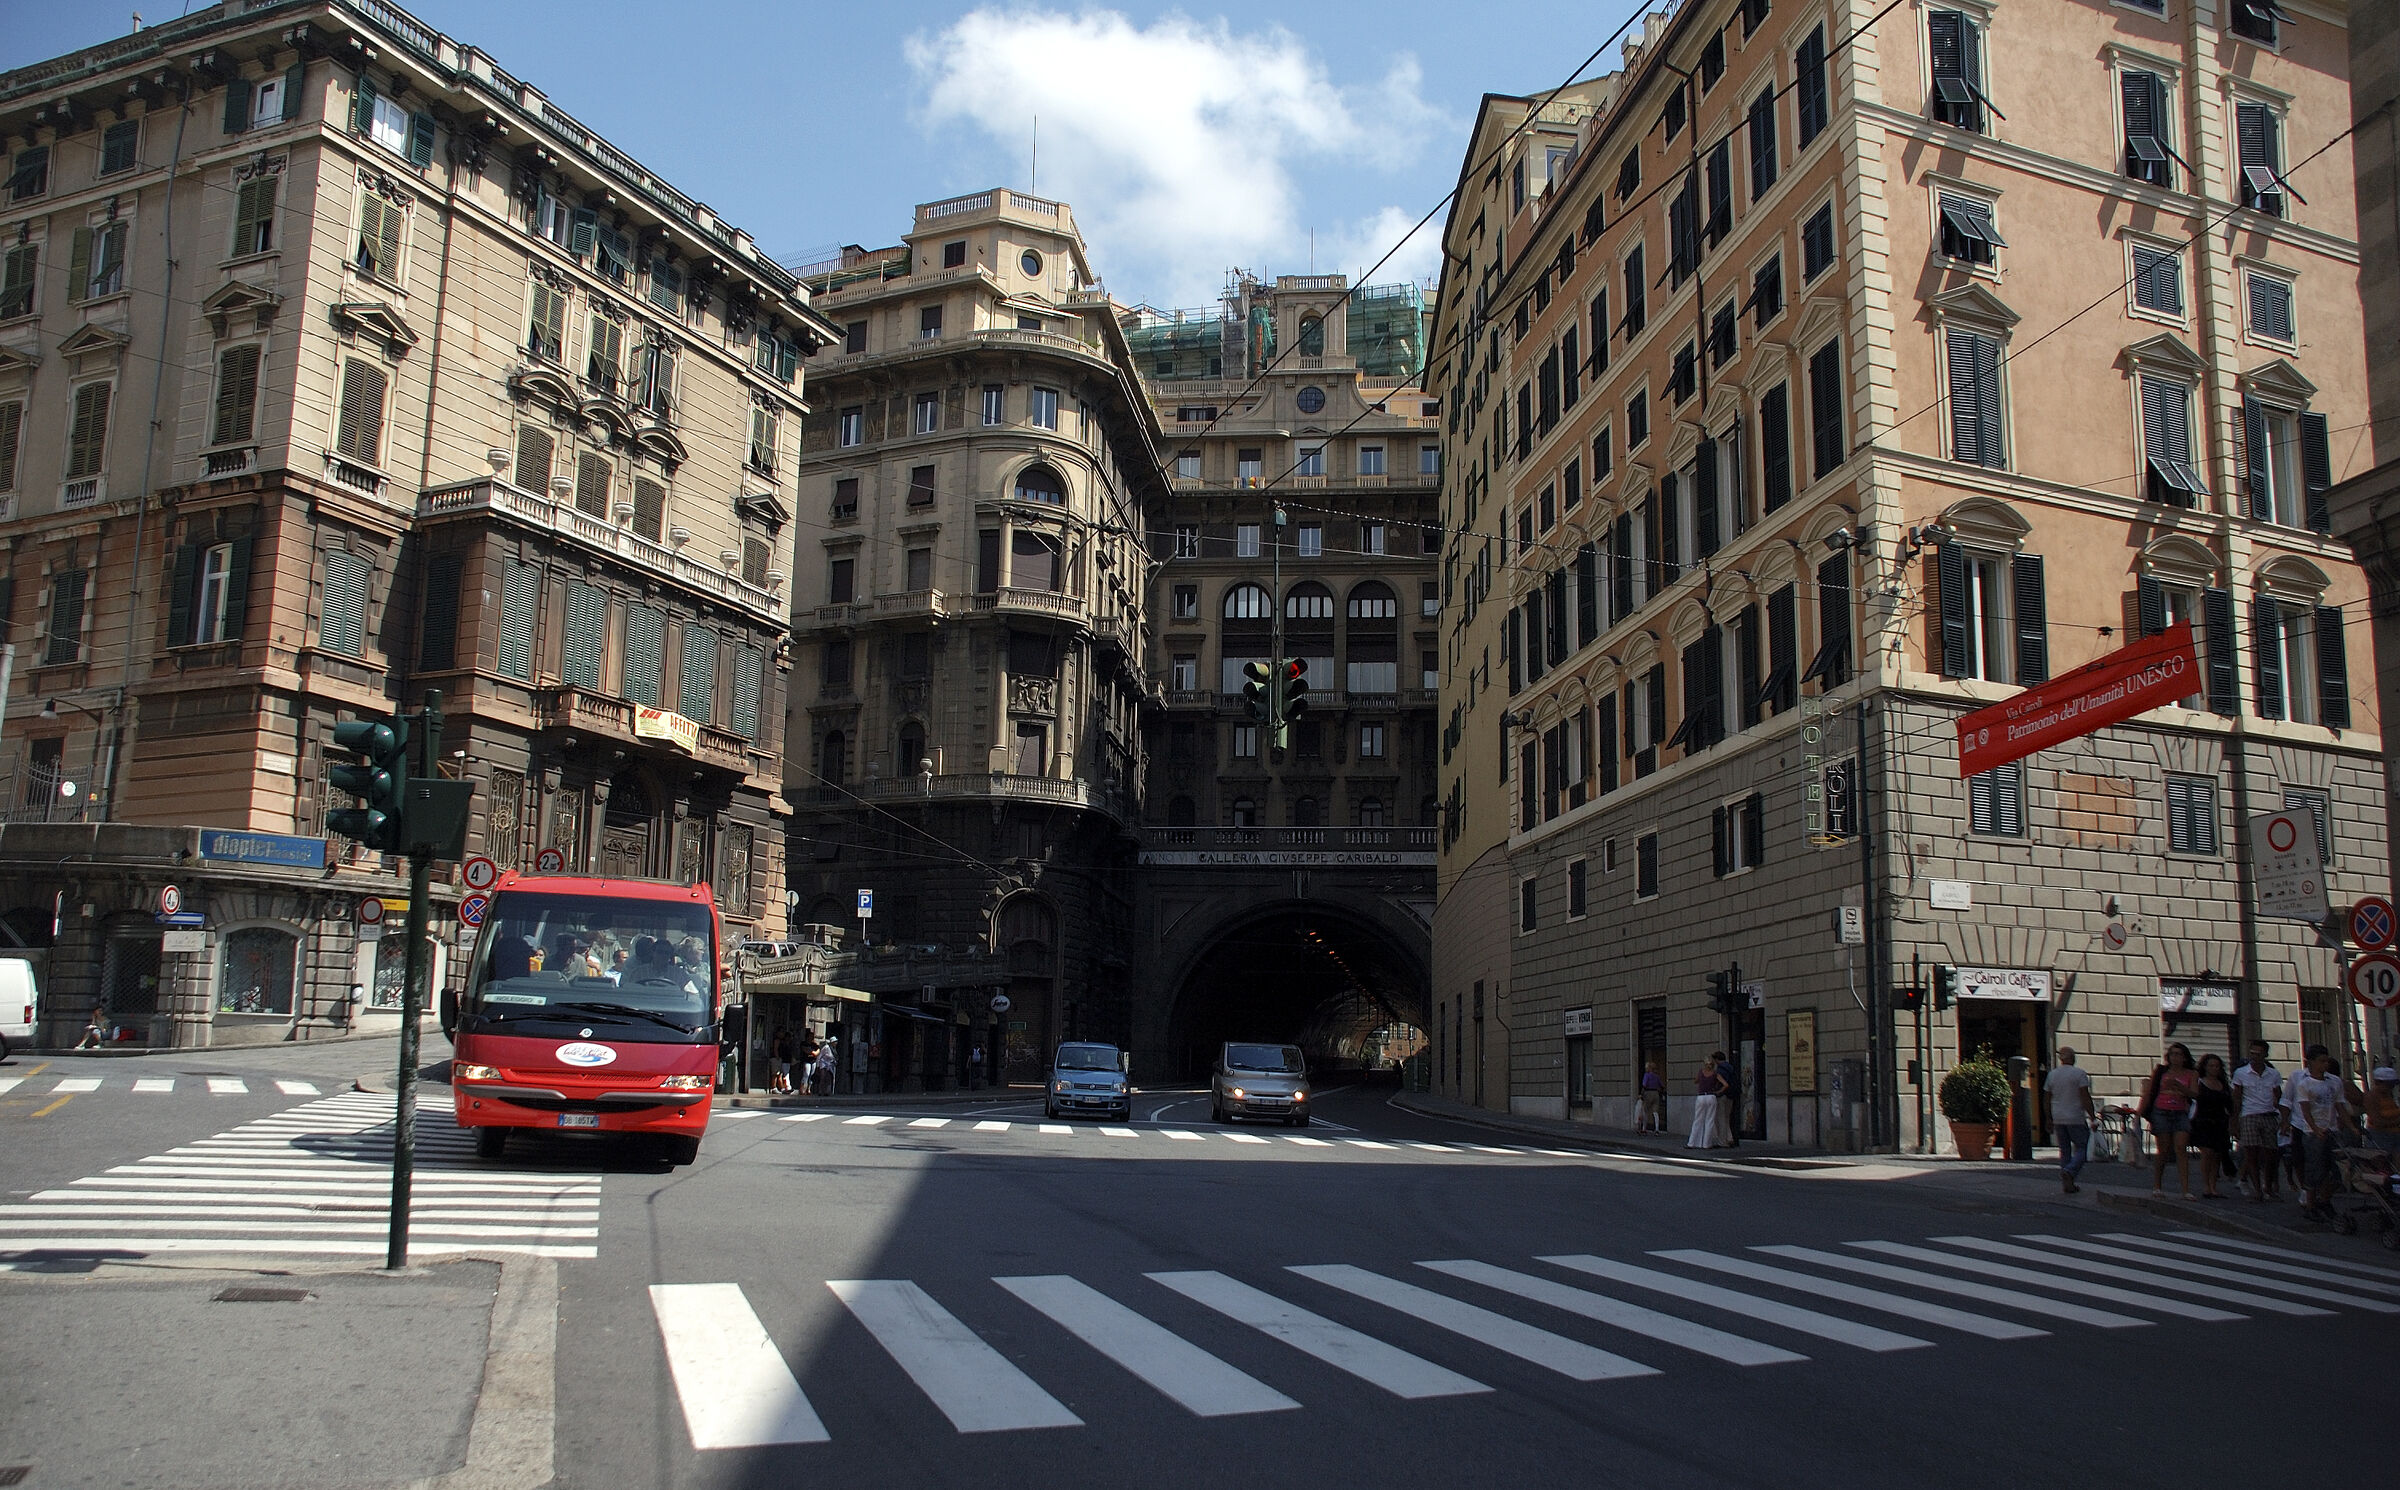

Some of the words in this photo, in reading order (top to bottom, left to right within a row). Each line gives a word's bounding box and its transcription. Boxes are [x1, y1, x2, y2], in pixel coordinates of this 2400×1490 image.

[2006, 706, 2018, 720] Via
[2018, 695, 2043, 717] Cairoli
[2007, 711, 2057, 742] Patrimonio
[2060, 681, 2125, 722] dell'Umanità
[2126, 654, 2185, 694] UNESCO
[1826, 698, 1846, 832] CROLI
[213, 835, 276, 858] diopter
[1199, 853, 1260, 864] GALLERIA
[1336, 853, 1403, 864] GARIBALDI
[471, 865, 480, 882] 4
[861, 896, 870, 907] P
[1974, 971, 2006, 985] Cairoli
[2364, 969, 2394, 994] 10
